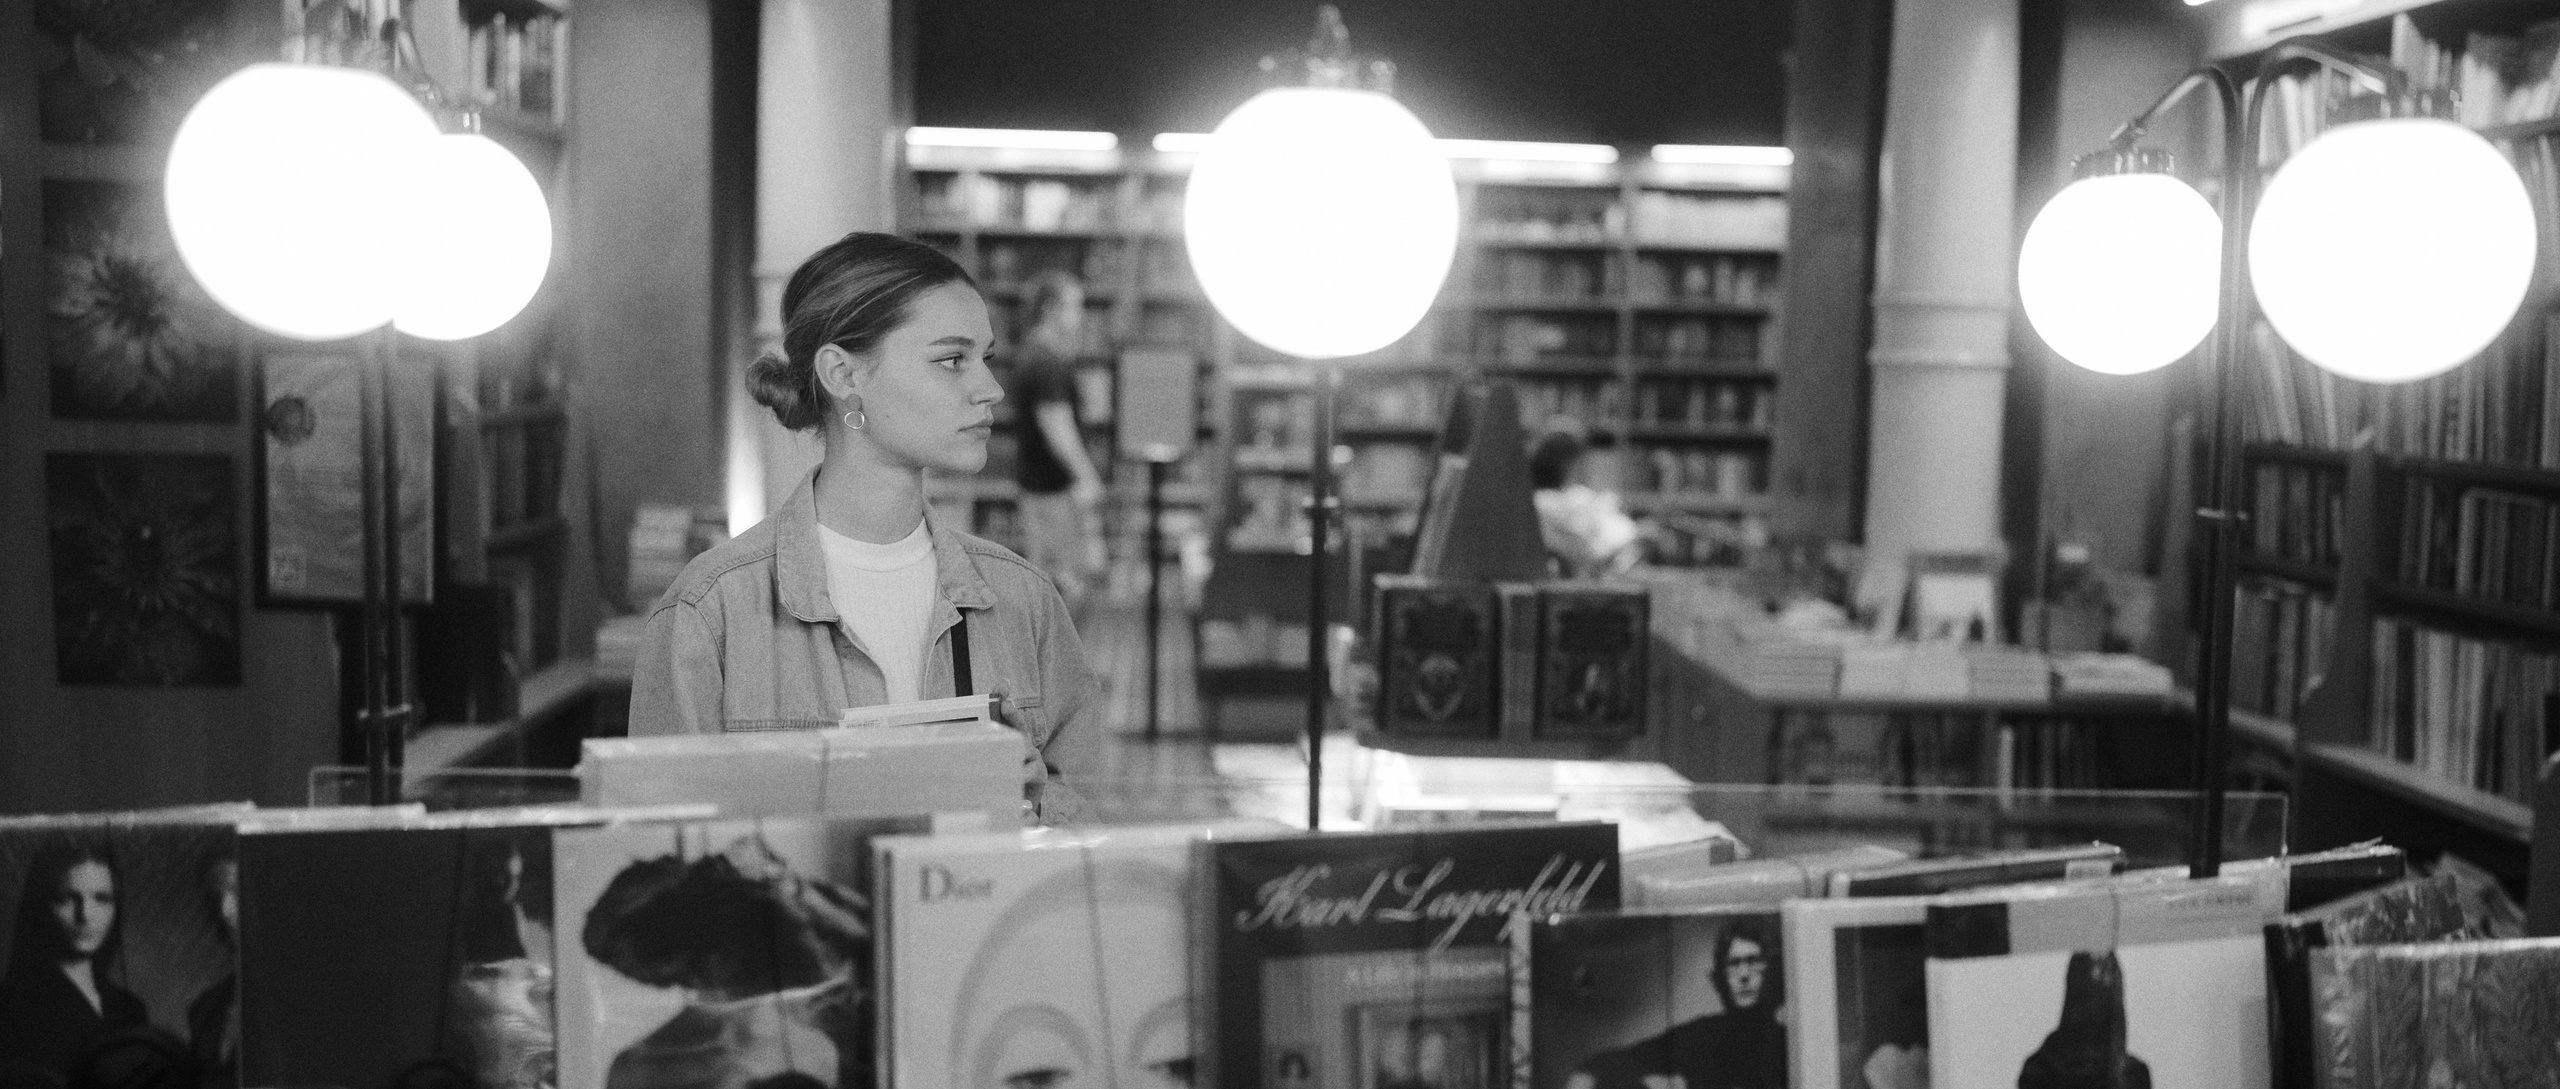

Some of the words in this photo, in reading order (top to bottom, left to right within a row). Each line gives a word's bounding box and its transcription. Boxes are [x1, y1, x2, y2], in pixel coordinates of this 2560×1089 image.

[919, 863, 992, 902] Dior
[1234, 863, 1390, 932] Karl
[1374, 852, 1606, 956] Lagerfeld
